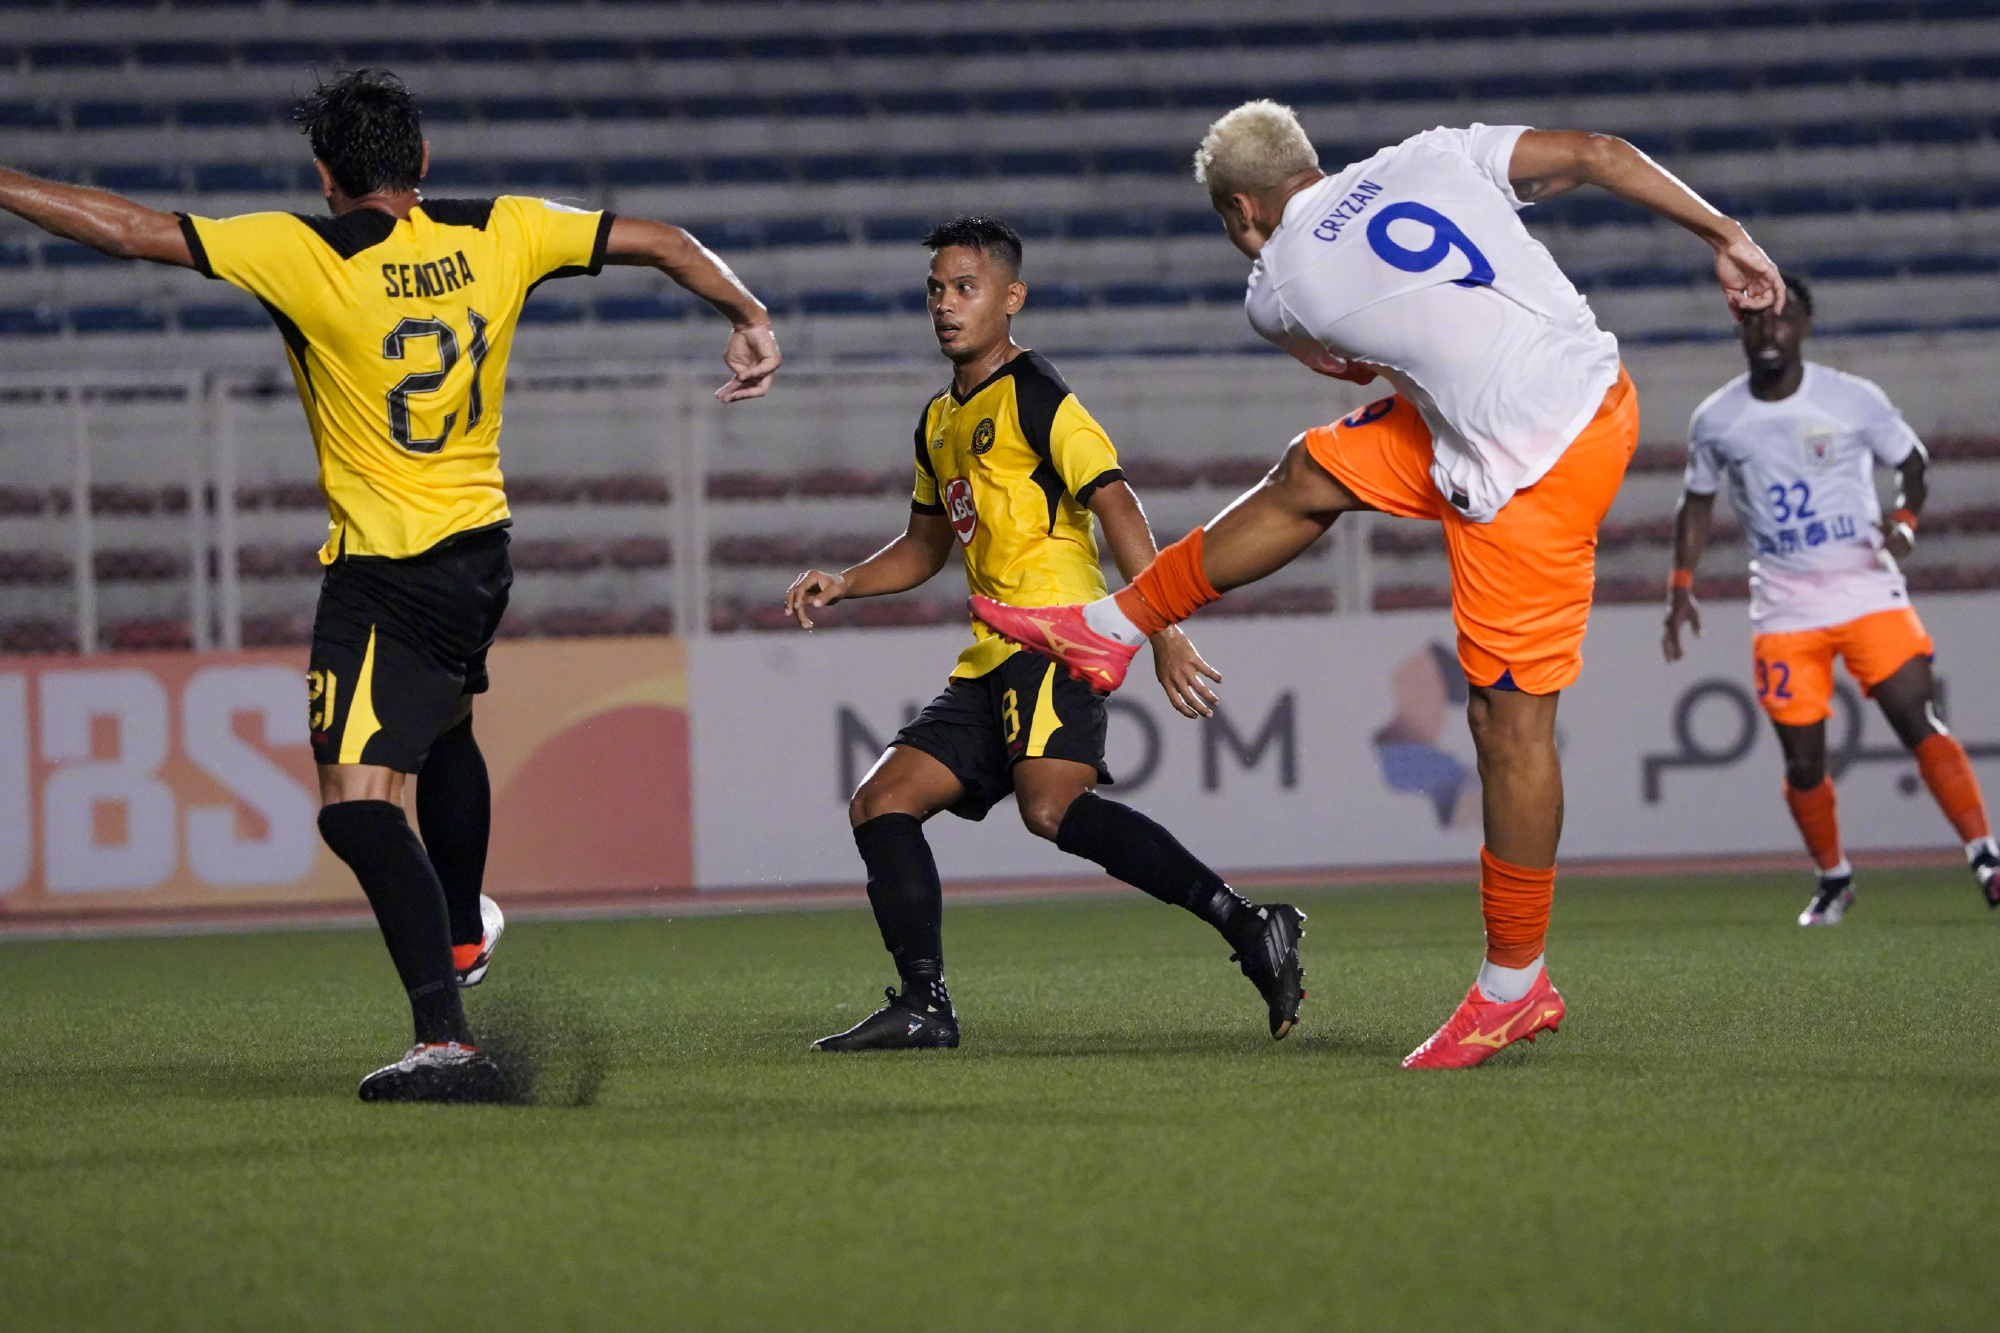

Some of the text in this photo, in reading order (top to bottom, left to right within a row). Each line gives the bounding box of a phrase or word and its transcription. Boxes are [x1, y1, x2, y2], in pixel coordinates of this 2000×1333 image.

[1313, 180, 1383, 242] CRYZAN
[1366, 201, 1496, 288] 9
[382, 250, 475, 298] SENDRA
[383, 306, 488, 454] 21
[949, 494, 977, 522] LBC
[1768, 480, 1816, 523] 32
[1756, 657, 1793, 698] 32
[1002, 688, 1020, 744] 8
[837, 688, 1298, 802] NOM
